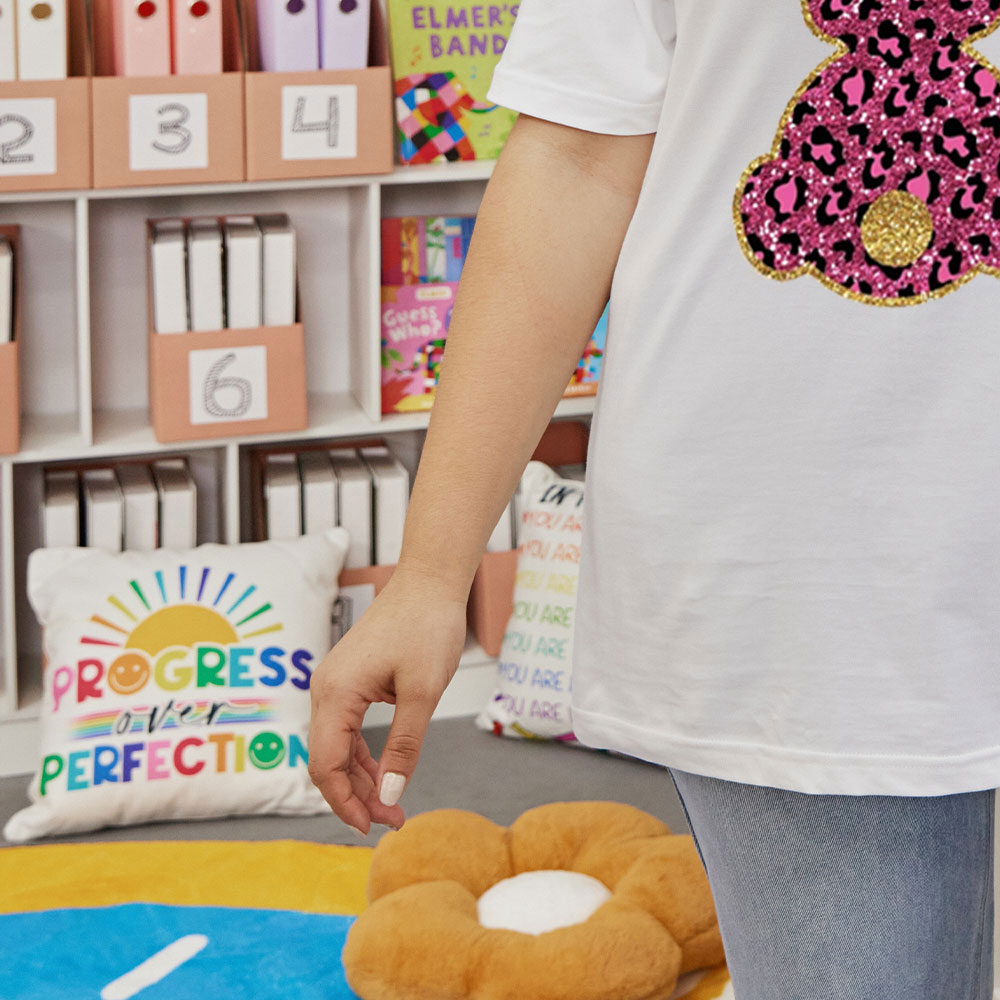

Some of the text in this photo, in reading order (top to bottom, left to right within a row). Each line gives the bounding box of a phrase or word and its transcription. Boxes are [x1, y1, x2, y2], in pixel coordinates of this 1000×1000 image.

[430, 33, 508, 58] BAND
[0, 113, 34, 164] 2
[152, 102, 192, 155] 3
[291, 95, 339, 148] 4
[383, 306, 438, 328] Guess
[204, 352, 253, 418] 6
[51, 645, 313, 713] PROGRESS
[115, 699, 242, 735] over
